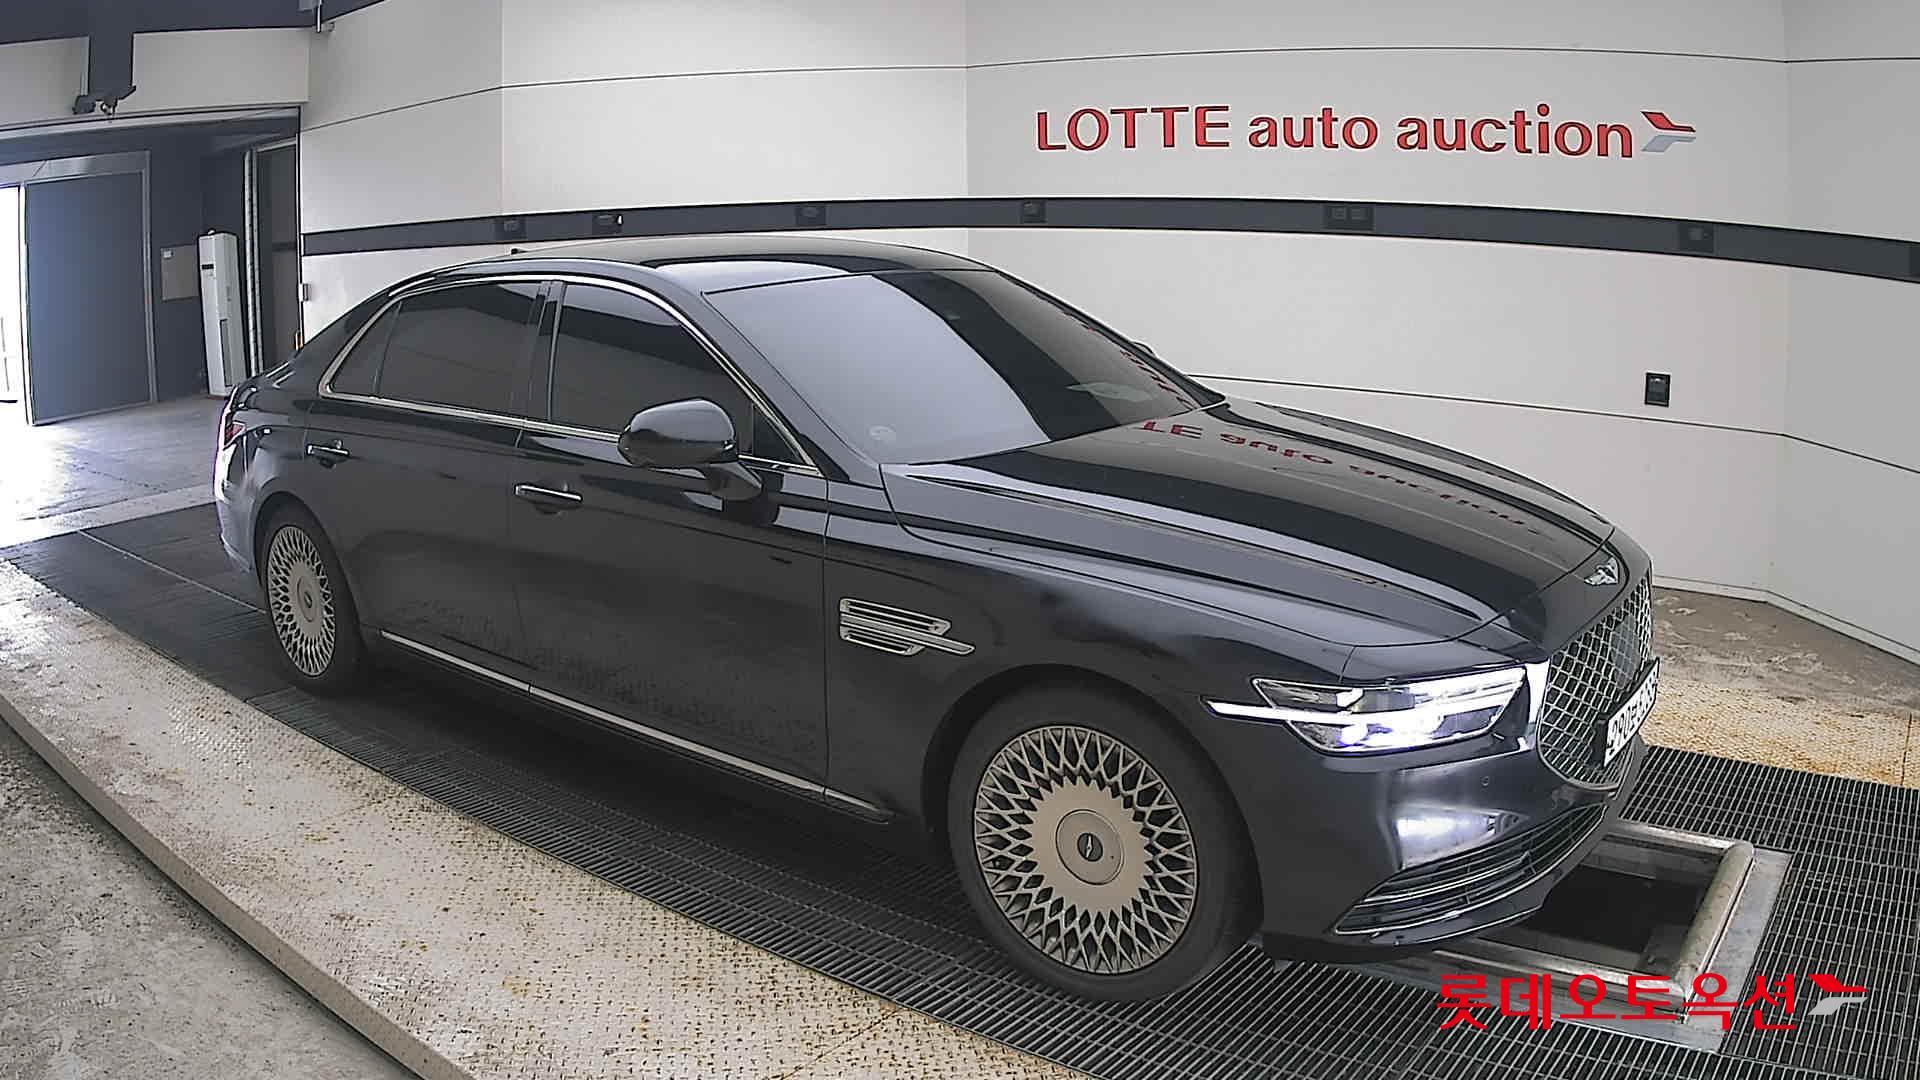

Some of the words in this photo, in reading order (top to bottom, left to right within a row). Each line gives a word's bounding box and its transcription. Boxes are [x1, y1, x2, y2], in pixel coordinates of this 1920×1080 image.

[1036, 105, 1231, 152] LOTTE
[1248, 107, 1379, 150] auto
[1396, 104, 1634, 158] auction
